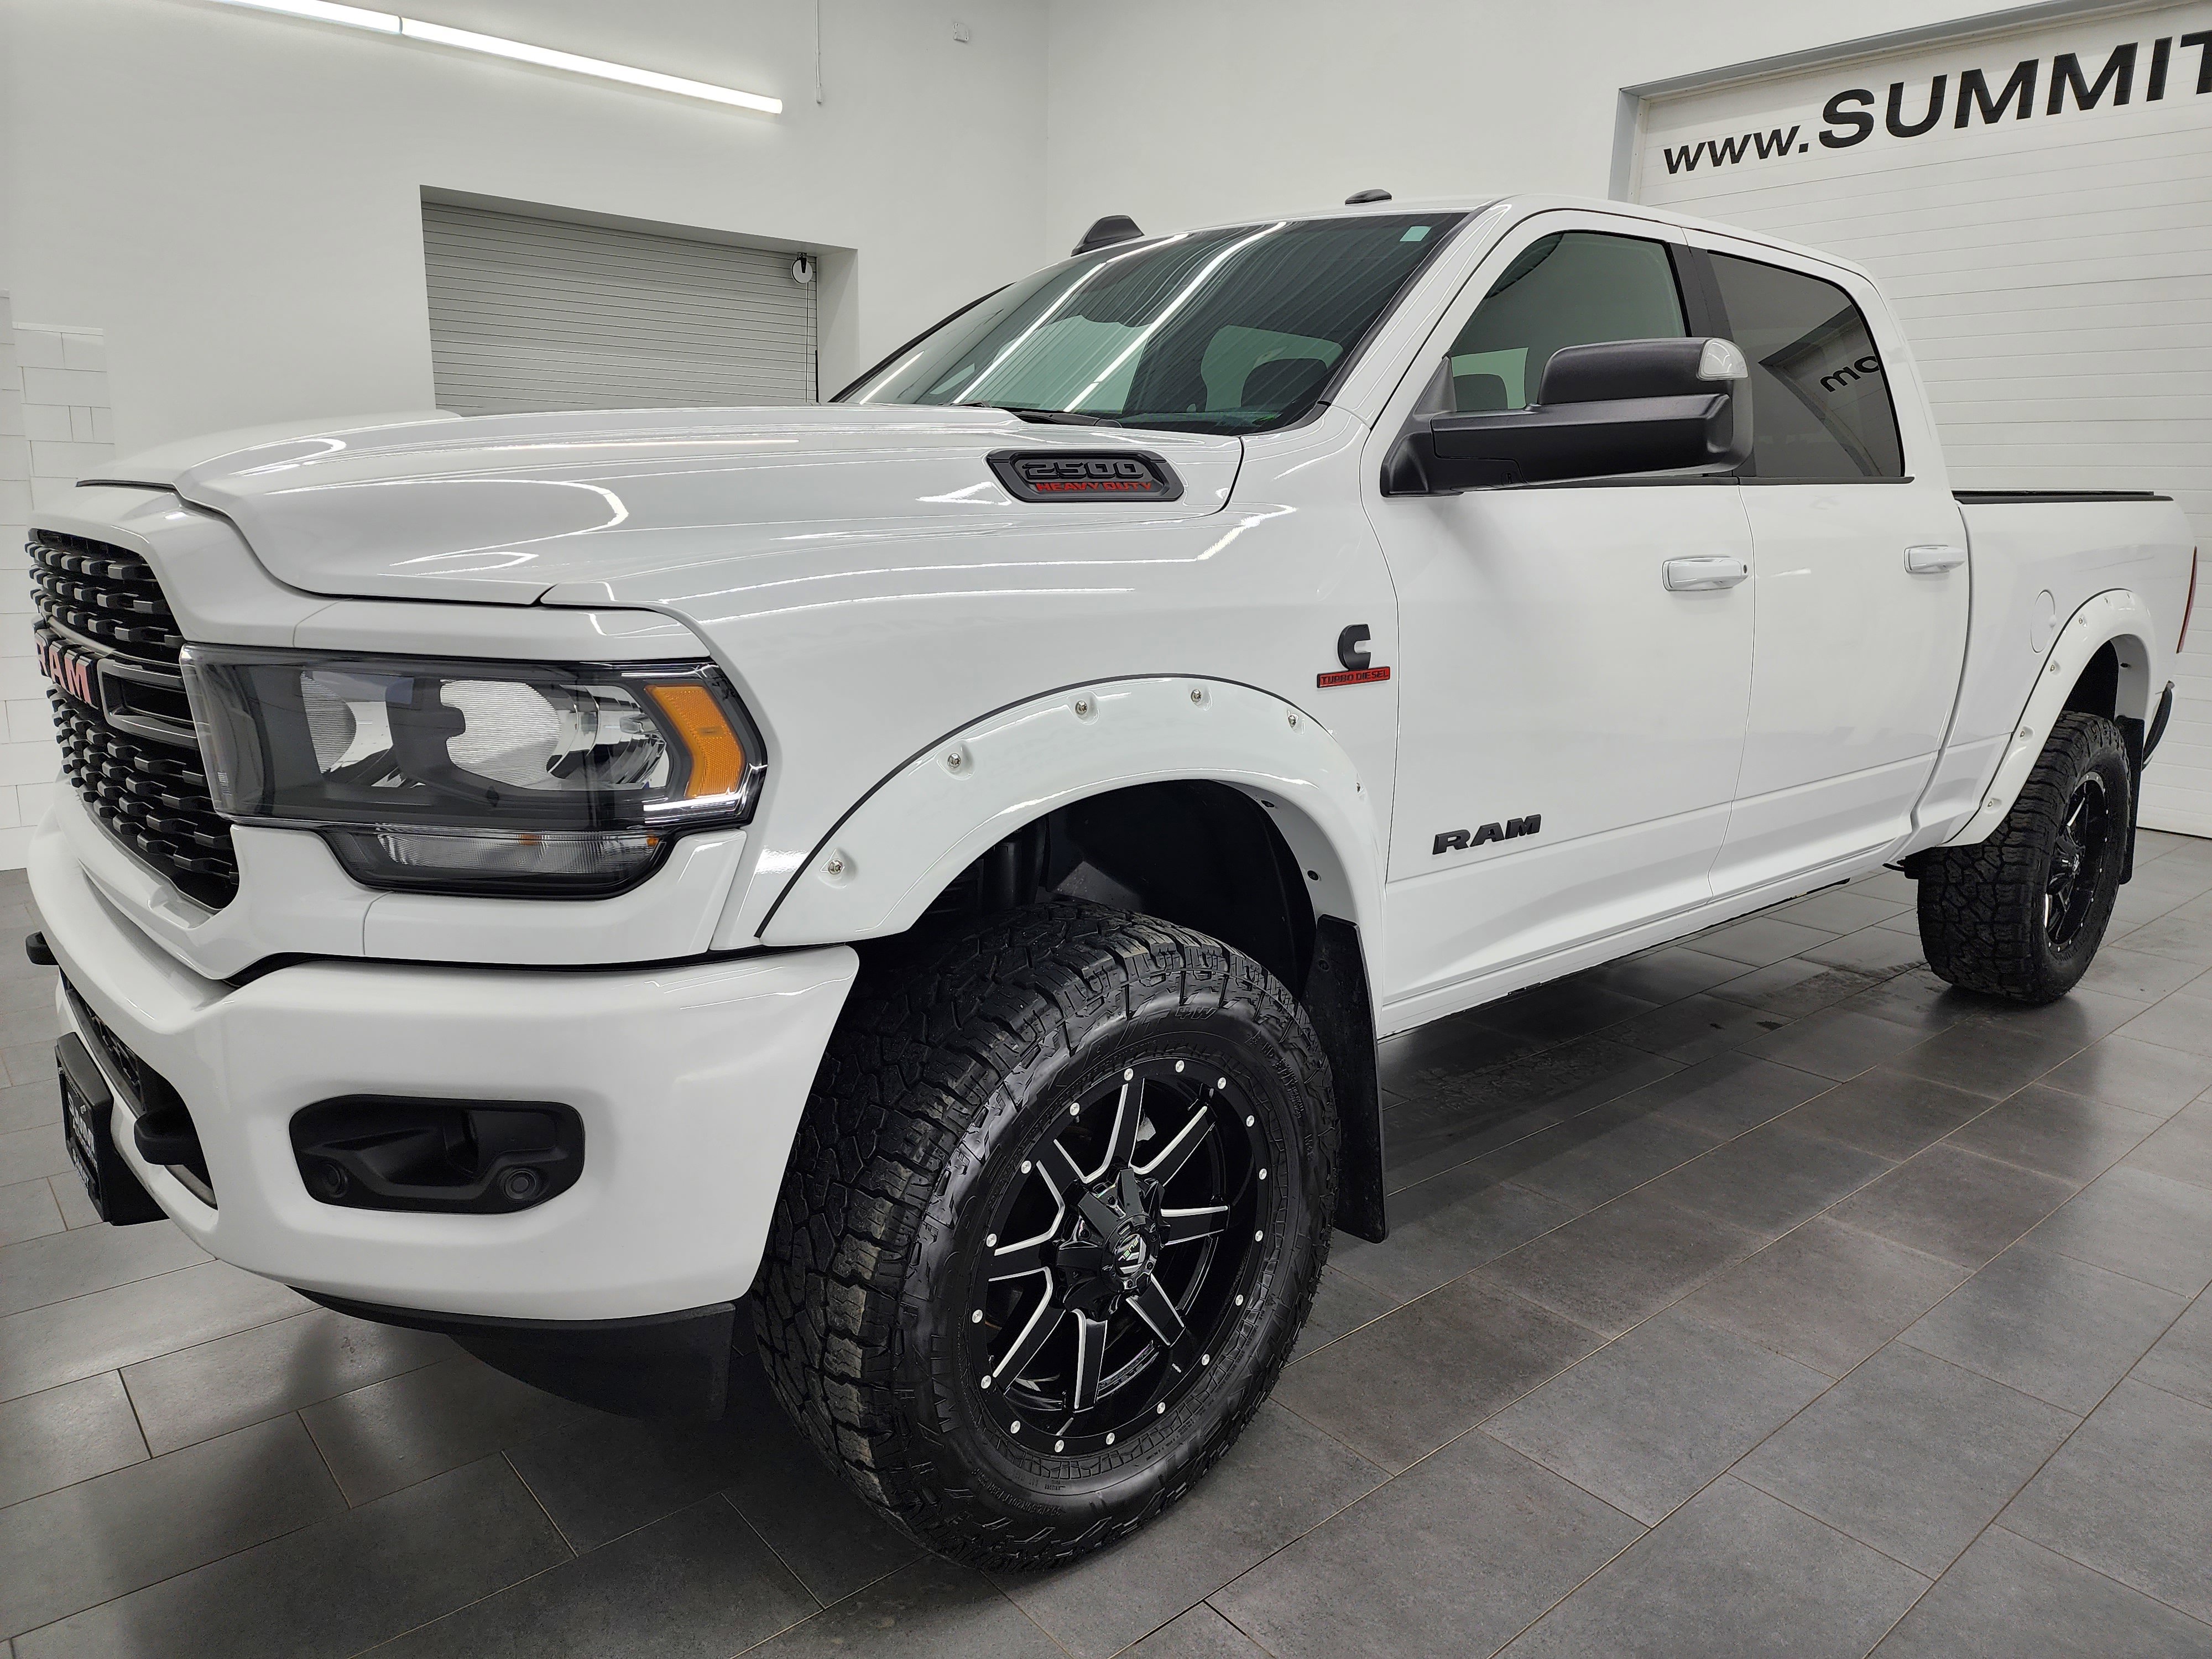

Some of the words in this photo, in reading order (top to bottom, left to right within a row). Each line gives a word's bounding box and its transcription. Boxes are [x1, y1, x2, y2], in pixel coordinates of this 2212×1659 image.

[1022, 462, 1144, 479] 2500
[1034, 482, 1099, 492] HEAVY
[1102, 482, 1152, 491] DUTY
[34, 632, 95, 708] RAM
[1321, 674, 1354, 685] TURBO
[1355, 670, 1389, 681] DIESEL
[1432, 814, 1542, 855] RAM
[1118, 1237, 1139, 1261] FUEL
